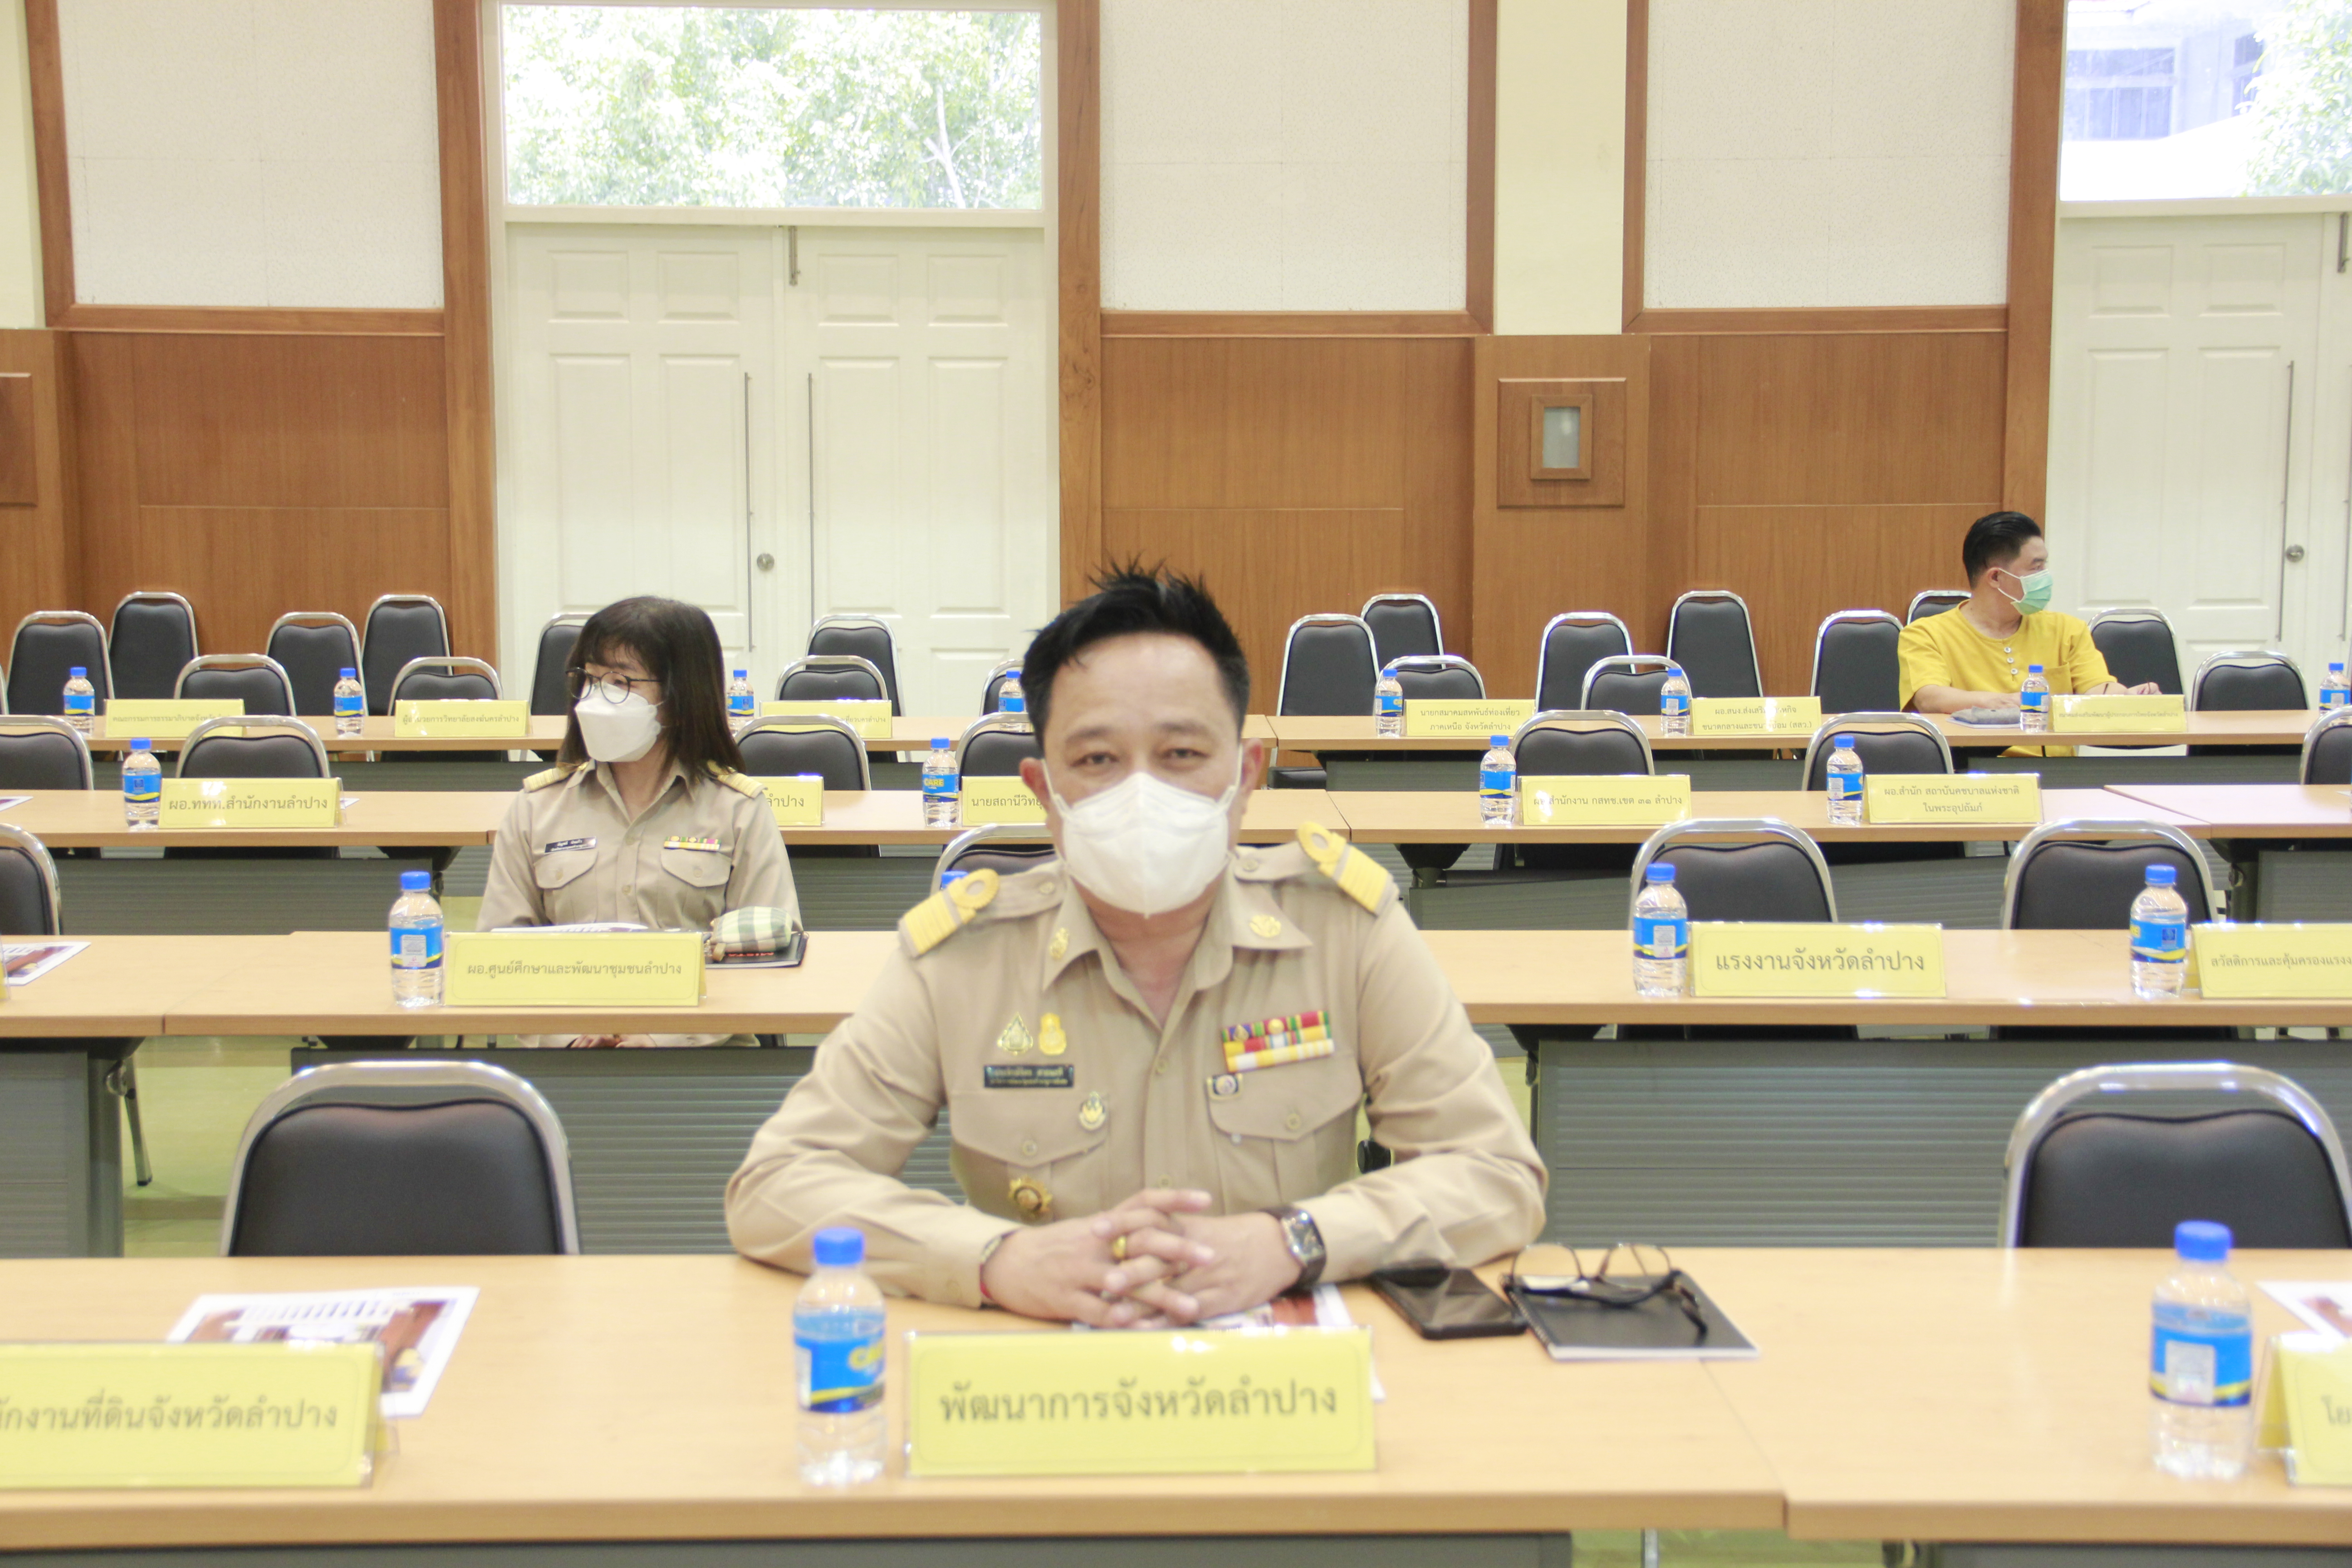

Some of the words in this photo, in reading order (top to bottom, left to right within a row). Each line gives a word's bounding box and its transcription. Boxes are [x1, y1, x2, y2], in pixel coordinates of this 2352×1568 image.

[1421, 706, 1520, 716] นายกสมาคมสหพันธ์ท่องเที่ยว
[1430, 722, 1462, 730] ภาคเหนือ
[1465, 722, 1511, 730] จังหวัดลำปาง
[924, 778, 944, 787] CARE
[1884, 786, 1922, 795] ผอ.สำนัก
[1926, 785, 2019, 795] สถาบันคชบาลแห่งชาติ
[169, 795, 328, 811] ผอ.ททท.สำนักงานลำปาง
[1592, 796, 1635, 805] กสทช.เขต
[1655, 795, 1682, 804] ลำปาง
[1923, 803, 1983, 815] ในพระอุปถัมภ์
[1716, 947, 1924, 970] แรงงานจังหวัดลำปาง
[467, 960, 681, 978] ผอ.ศูนย์ศึกษาและพัฒนาชุมชนลำปาง
[940, 1375, 1337, 1423] พัฒนาการจังหวัดลำปาง
[0, 1389, 337, 1431] ักงานที่ดินจังหวัดลำปาง
